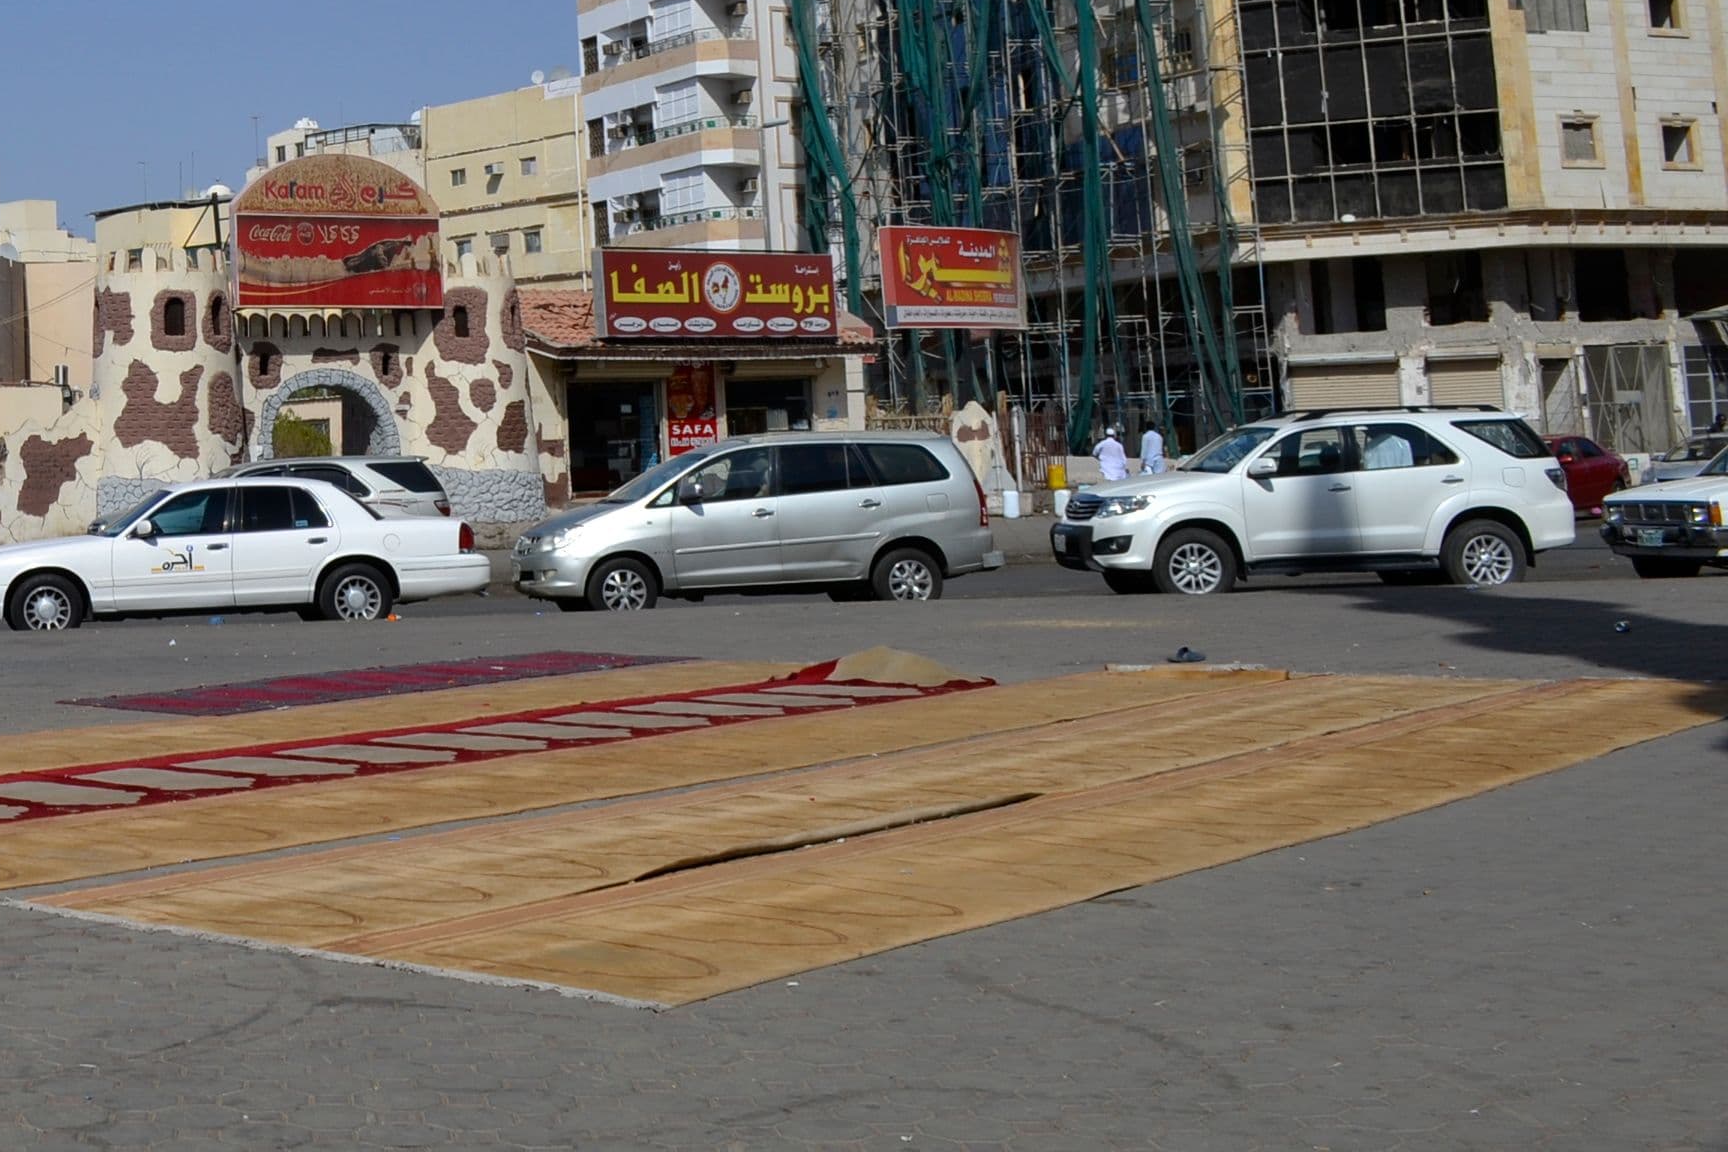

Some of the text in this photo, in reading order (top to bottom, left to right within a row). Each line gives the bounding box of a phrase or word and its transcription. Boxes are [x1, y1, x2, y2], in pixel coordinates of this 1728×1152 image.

[263, 180, 327, 201] Karam
[360, 180, 419, 204] كرم
[956, 240, 996, 263] المدينة
[609, 263, 700, 304] الصفا
[745, 273, 830, 314] بروست
[671, 424, 714, 435] SAFA
